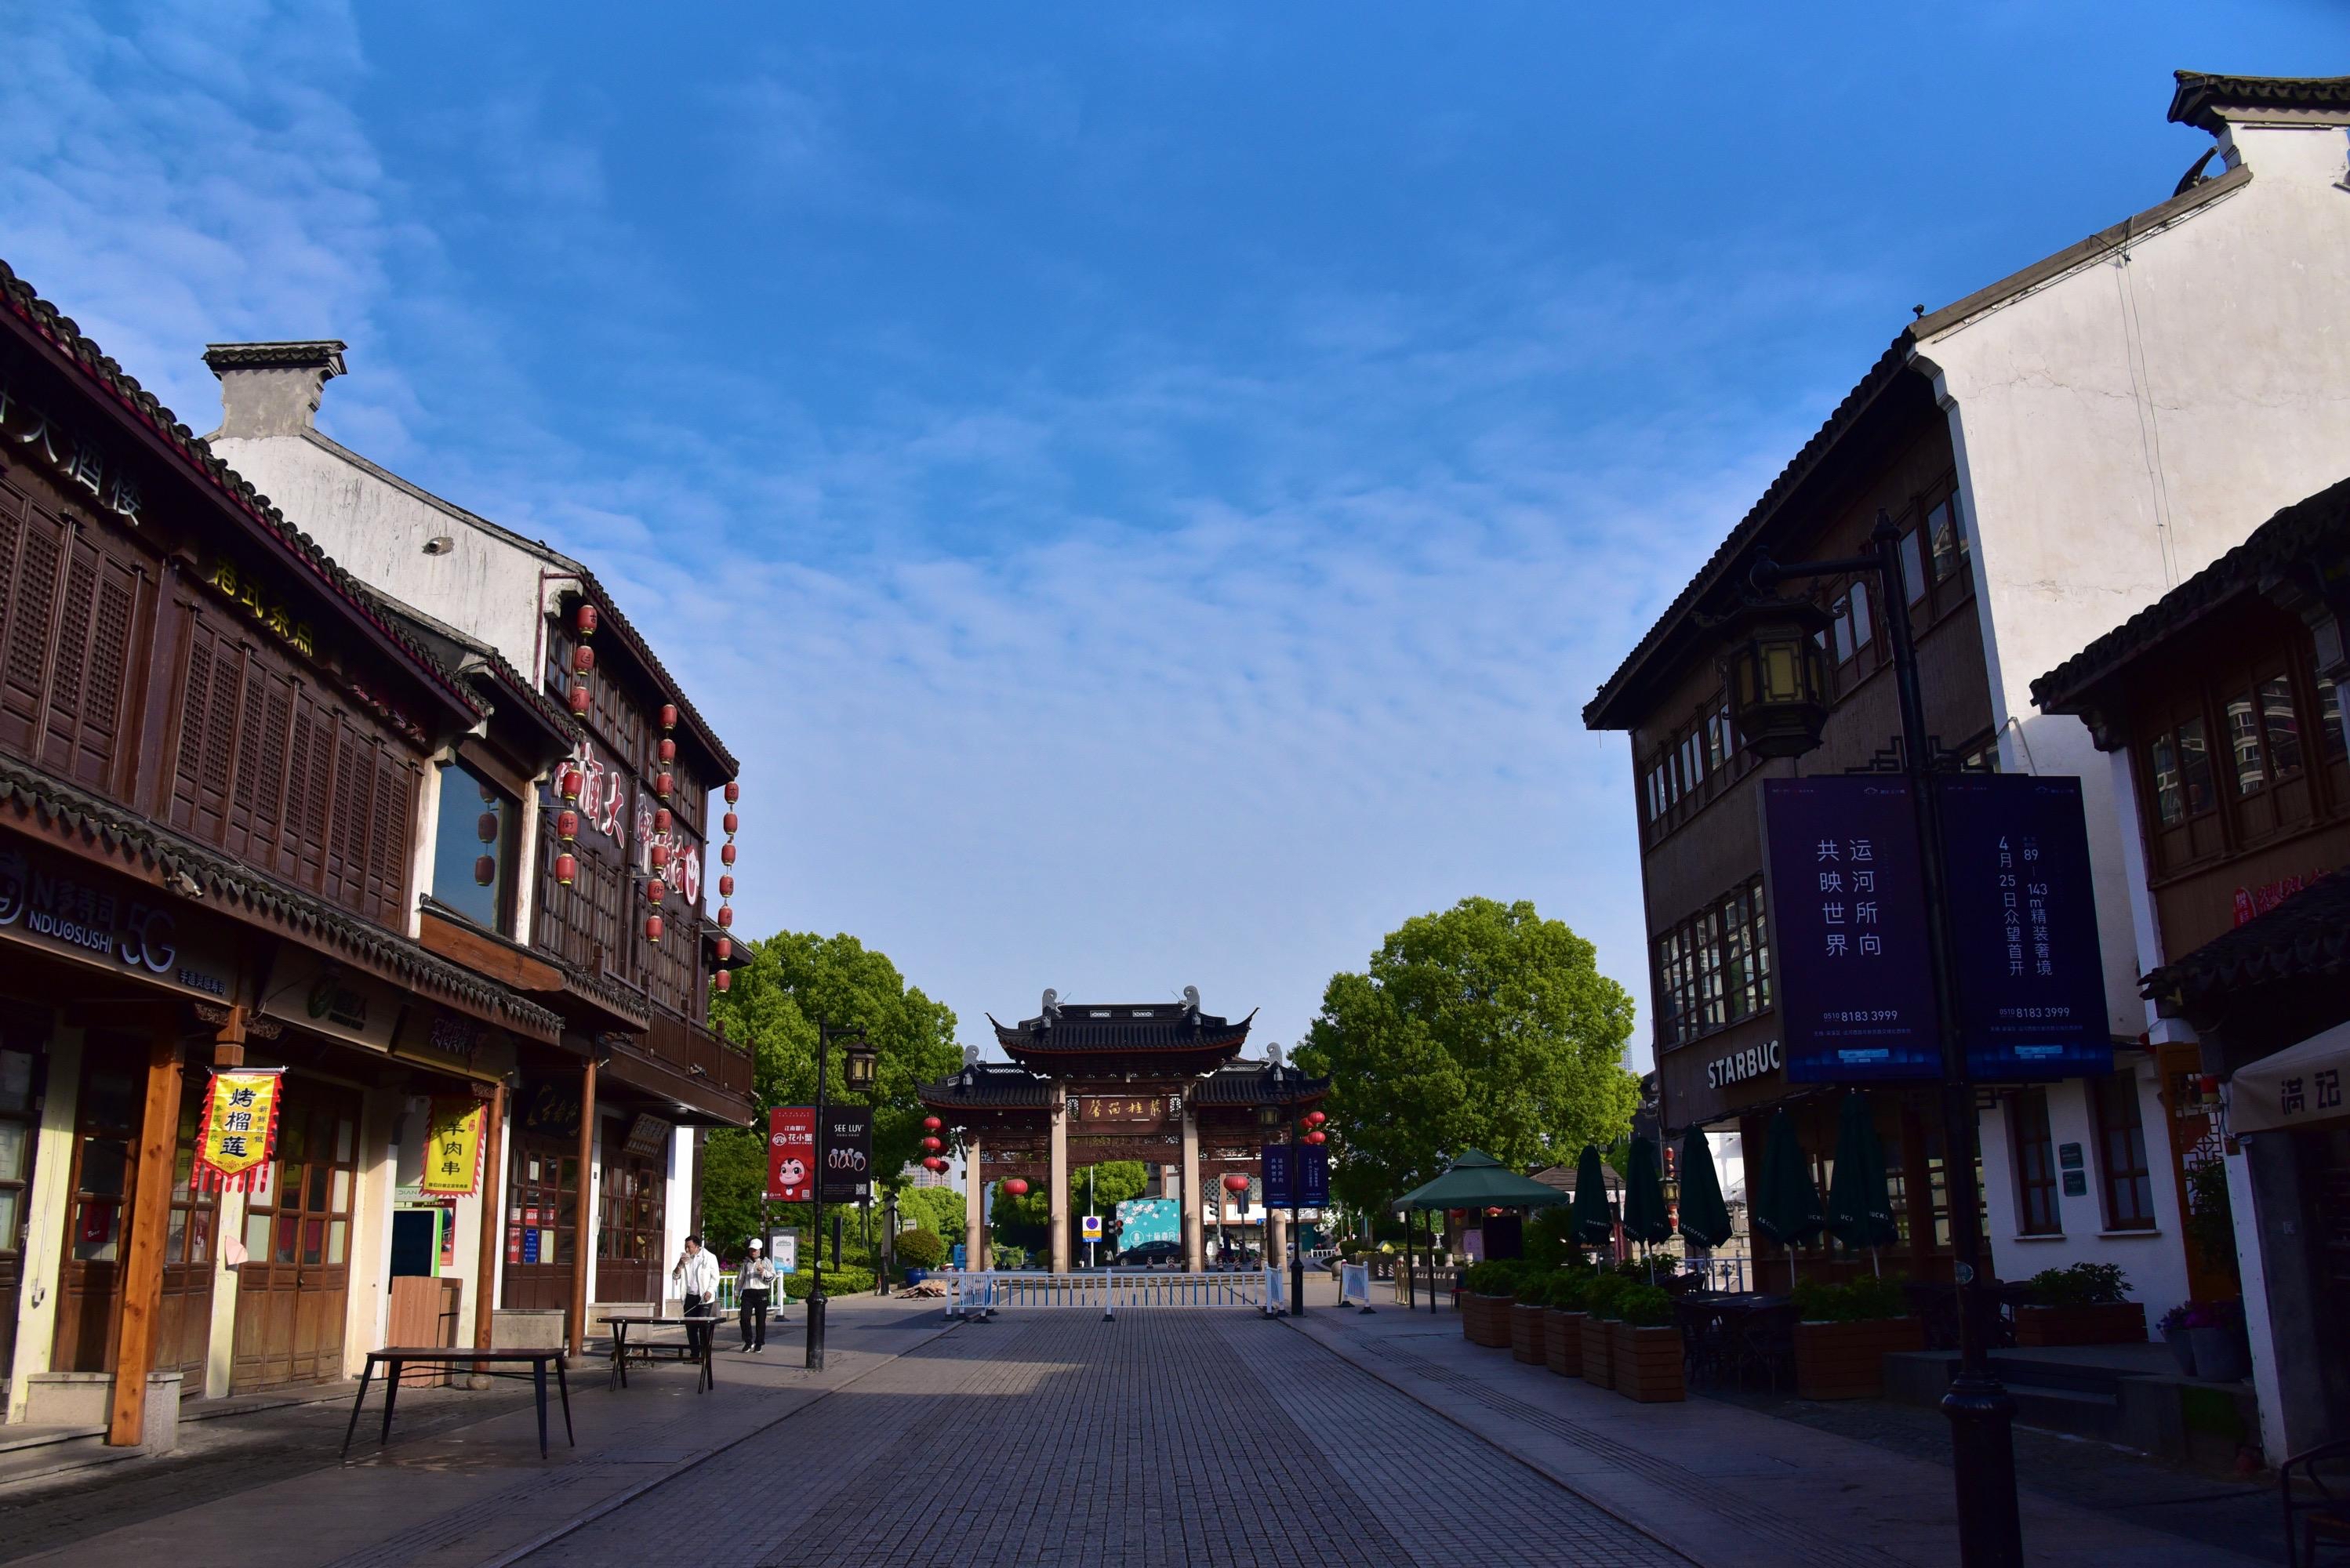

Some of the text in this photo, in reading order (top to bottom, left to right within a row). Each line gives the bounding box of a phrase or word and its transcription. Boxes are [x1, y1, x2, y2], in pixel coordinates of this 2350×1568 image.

[1817, 839, 1849, 957] 共映世界
[1849, 838, 1881, 956] 运河所向
[29, 910, 113, 954] NDUOSUSHI
[1841, 1011, 1869, 1022] 8183
[1871, 1010, 1898, 1022] 3999
[2016, 1007, 2042, 1018] 8183
[2044, 1007, 2070, 1018] 3999
[1708, 1040, 1781, 1089] STARBUC
[2281, 1069, 2341, 1115] 满记
[220, 1087, 256, 1158] 烤榴莲
[834, 1124, 846, 1133] SEE
[441, 1121, 465, 1176] 羊肉串
